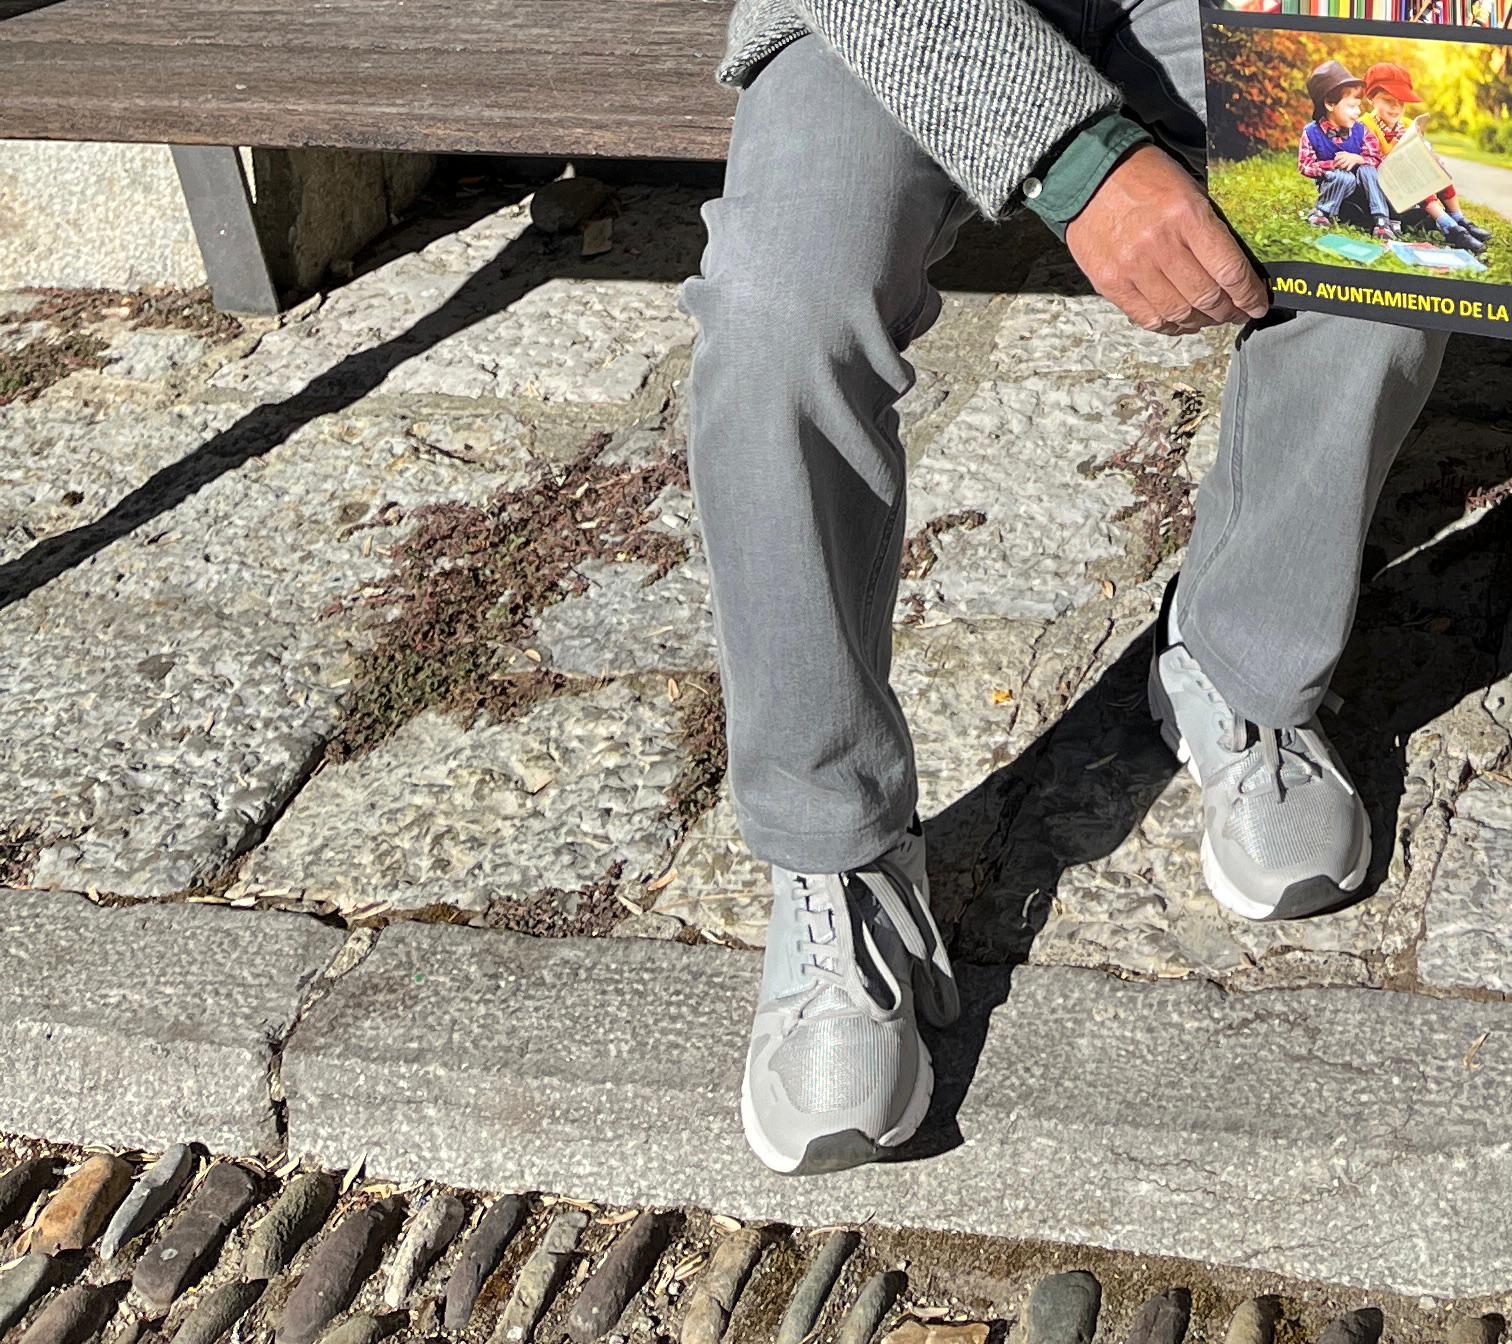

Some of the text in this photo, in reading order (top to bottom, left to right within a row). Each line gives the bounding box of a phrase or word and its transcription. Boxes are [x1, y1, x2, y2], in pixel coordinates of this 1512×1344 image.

[1271, 276, 1313, 297] MO.
[1315, 282, 1456, 315] AYUNTAMIENTO
[1459, 299, 1484, 319] DE
[1486, 302, 1510, 323] LA
